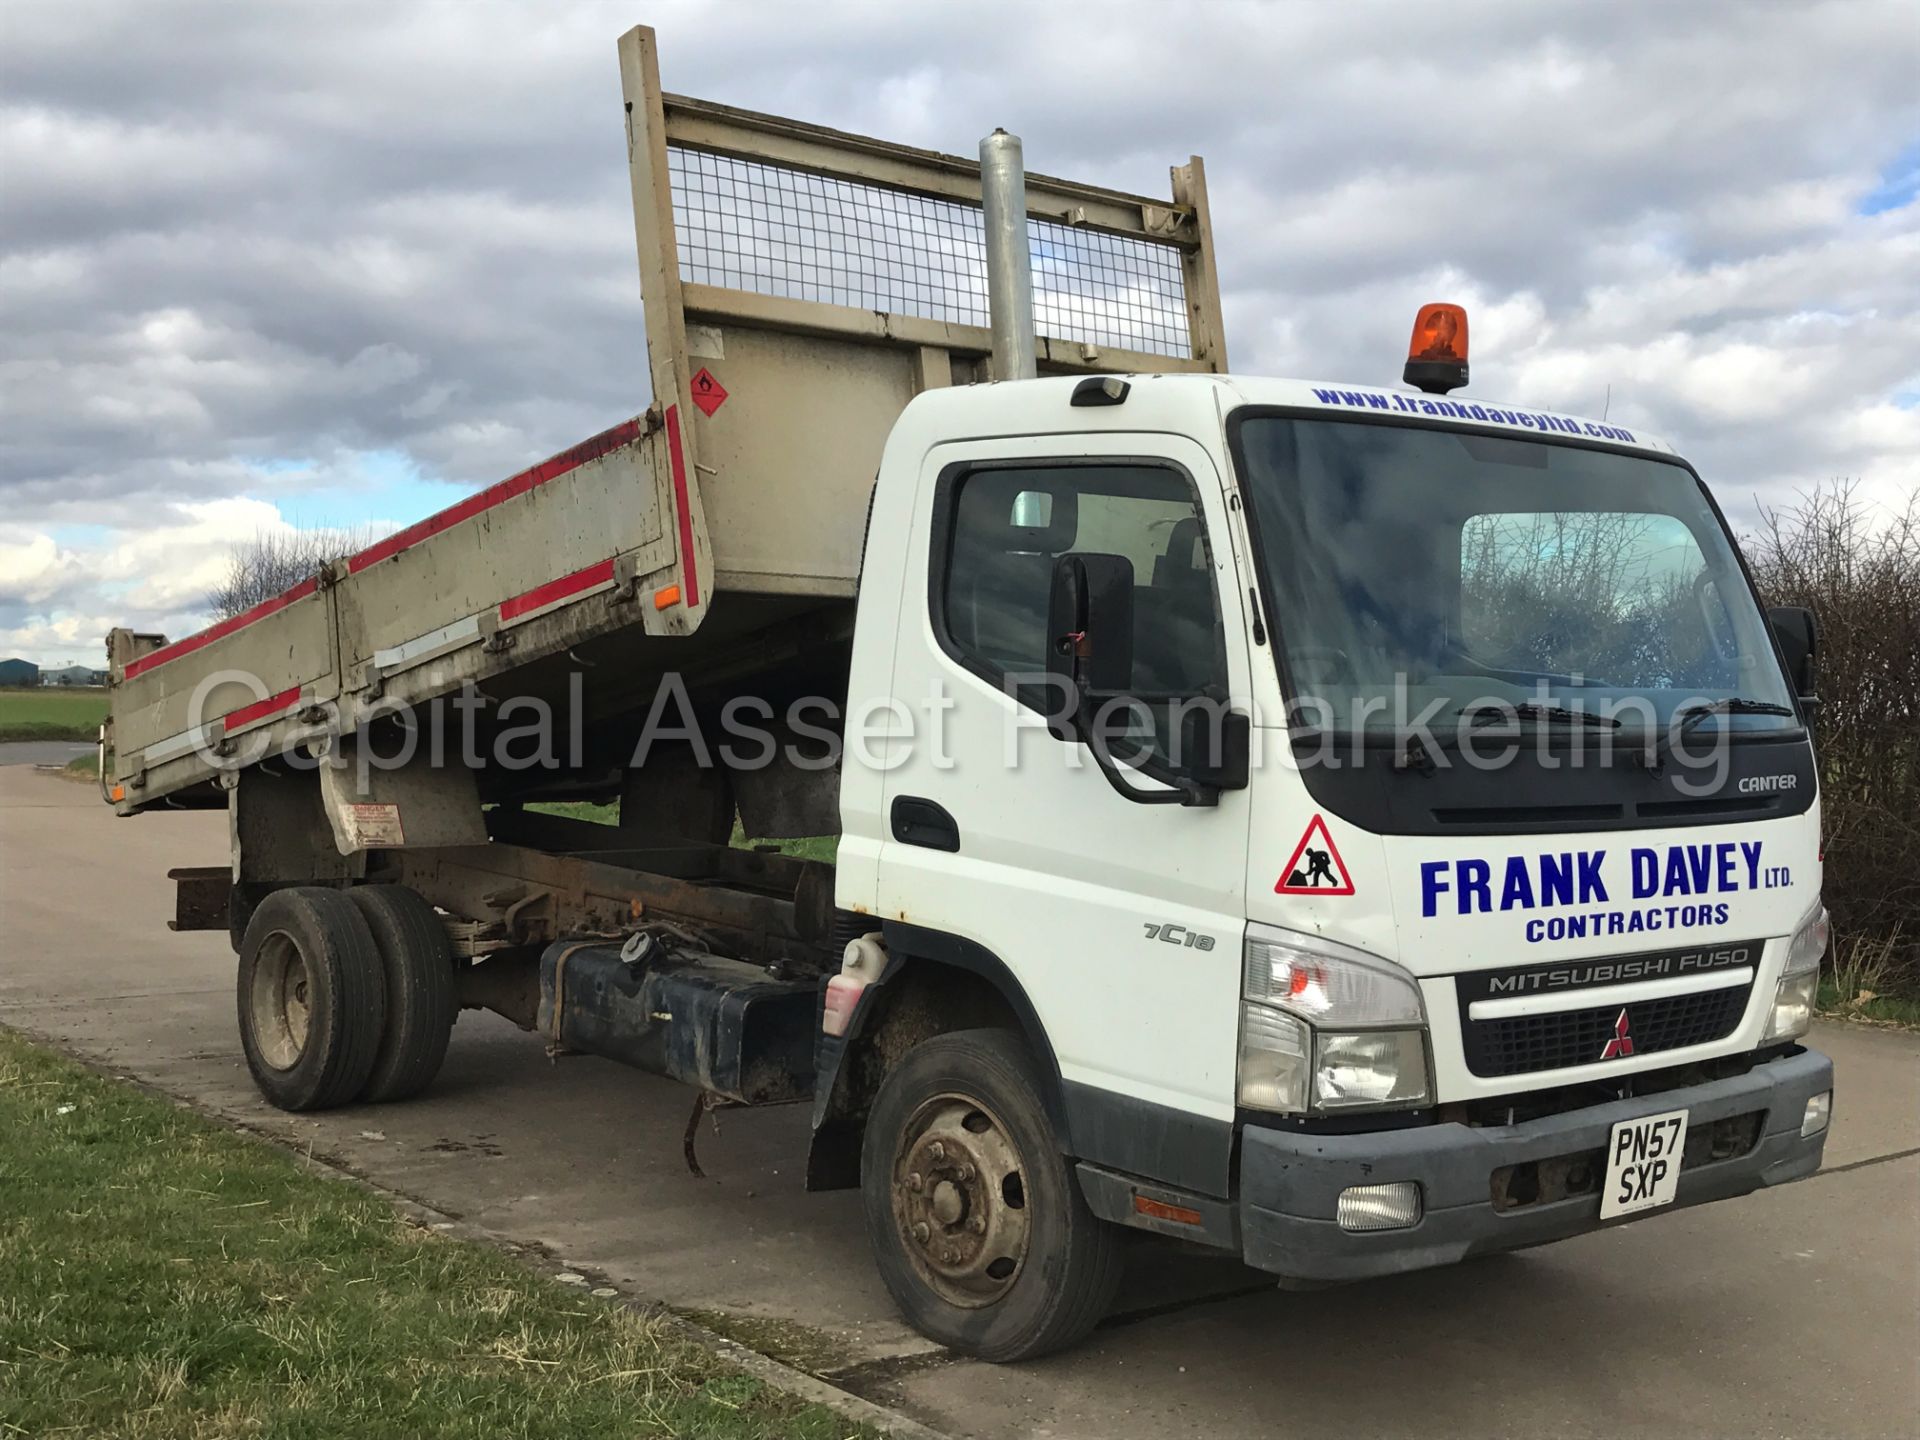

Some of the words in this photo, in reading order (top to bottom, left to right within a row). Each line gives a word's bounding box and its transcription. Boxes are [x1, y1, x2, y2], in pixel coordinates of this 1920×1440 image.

[1311, 388, 1637, 443] www.frankdaveyltd.com
[1738, 774, 1797, 792] CANTER
[1420, 850, 1610, 918] FRANK
[1630, 841, 1763, 900] DAVEY
[1765, 866, 1794, 890] LTD.
[1143, 923, 1216, 952] 7C18
[1526, 903, 1729, 943] CONTRACTORS
[1489, 957, 1671, 993] MITSUBISHI
[1679, 948, 1749, 969] FUSO
[1615, 1117, 1682, 1167] PN57
[1618, 1159, 1668, 1205] SXP
